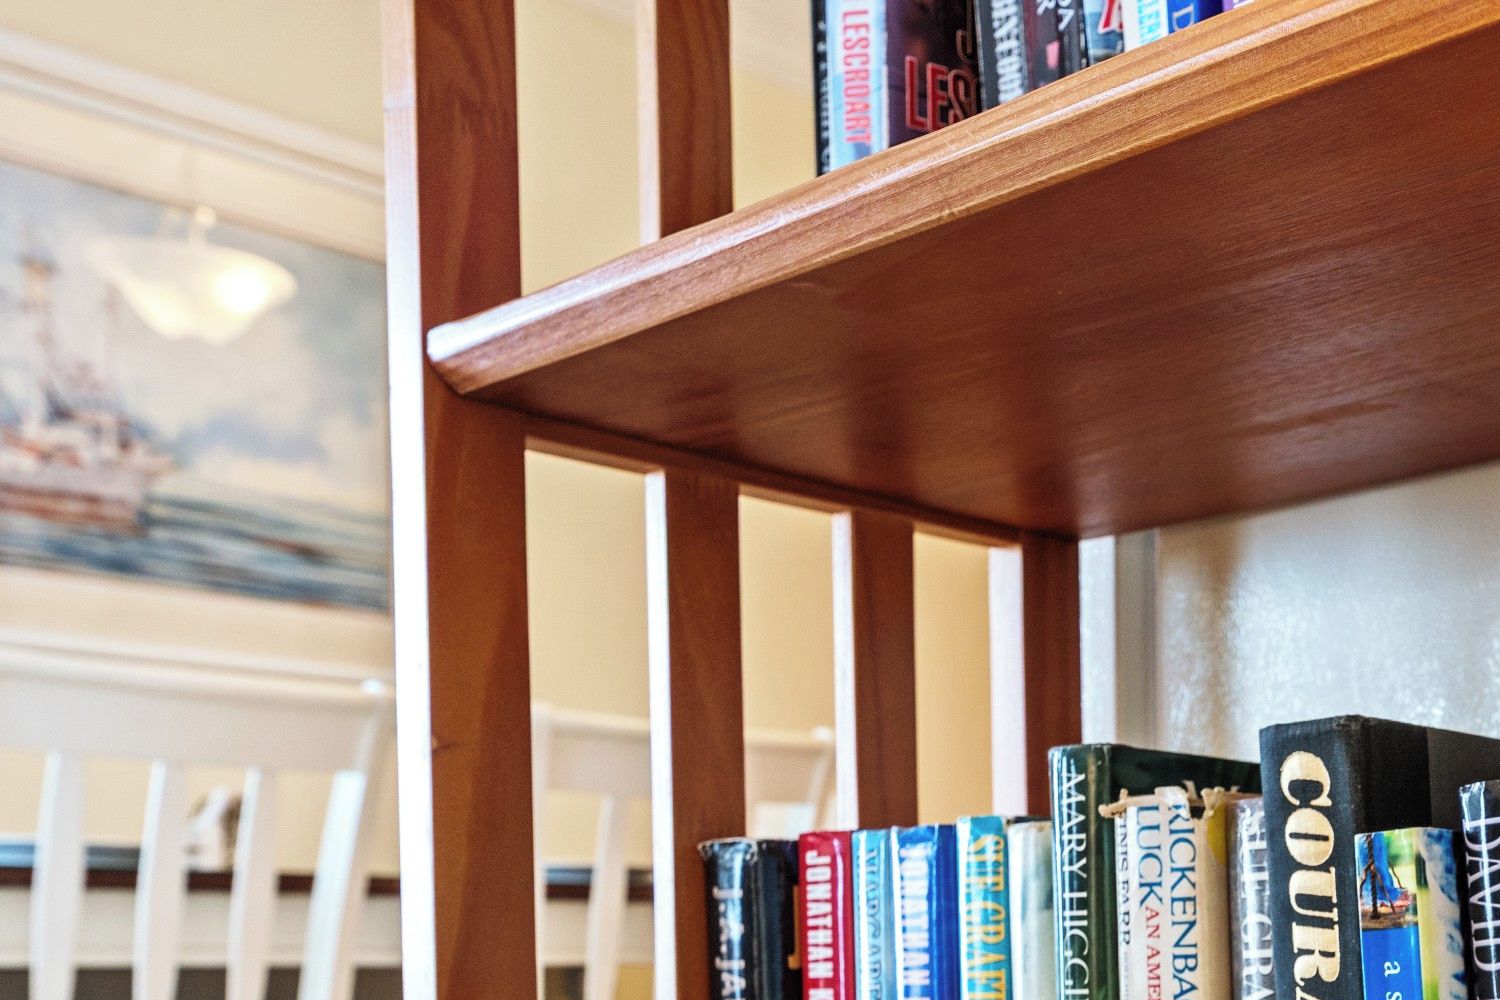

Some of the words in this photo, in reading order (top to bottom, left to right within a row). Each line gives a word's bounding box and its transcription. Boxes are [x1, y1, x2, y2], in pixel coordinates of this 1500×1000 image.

[843, 10, 872, 144] LESCROART
[966, 834, 1006, 893] SUE
[1061, 771, 1088, 879] MARY
[1136, 804, 1163, 909] LUCK
[805, 850, 834, 979] JONATHAN
[899, 842, 931, 987] JONATHAN
[1120, 879, 1131, 946] FARR
[1145, 906, 1160, 939] AN
[1384, 960, 1401, 976] a
